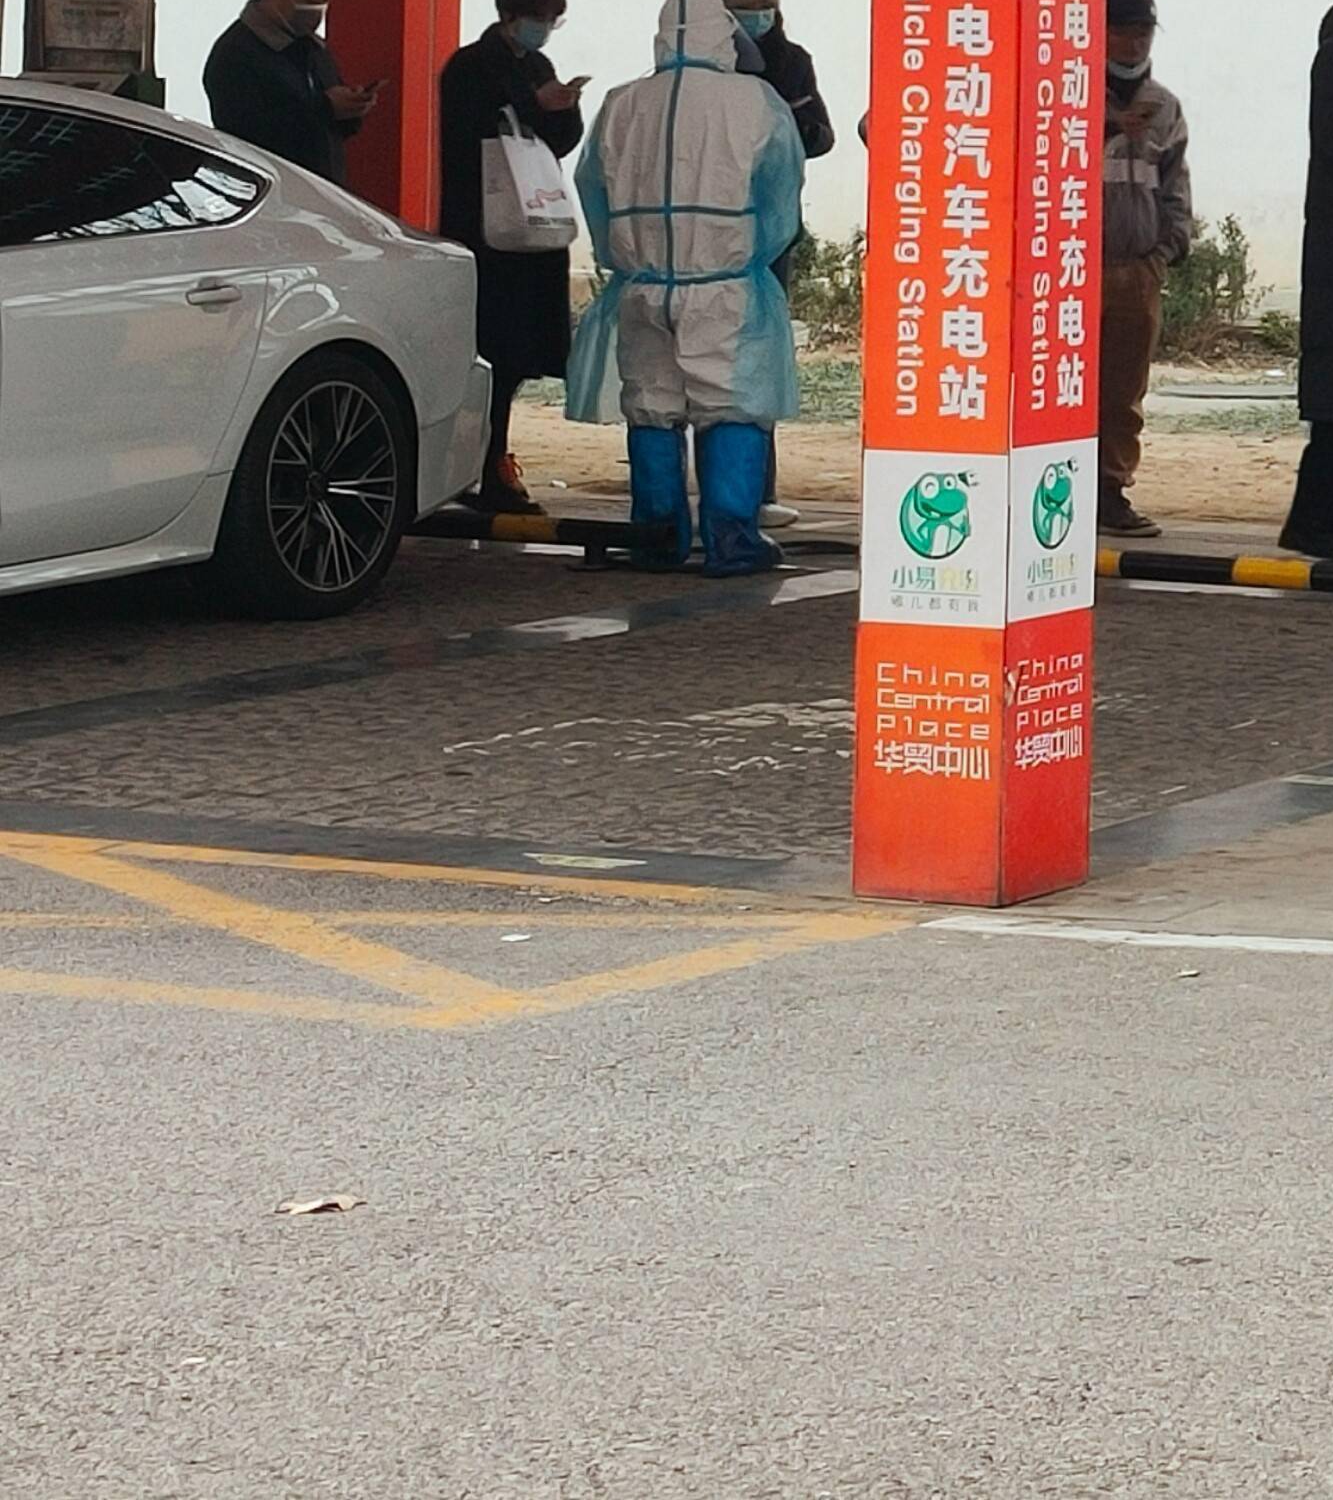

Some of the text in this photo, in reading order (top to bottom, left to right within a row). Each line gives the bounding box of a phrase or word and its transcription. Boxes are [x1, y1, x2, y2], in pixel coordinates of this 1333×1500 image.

[894, 84, 931, 263] Charging
[1031, 78, 1054, 258] Charging
[895, 277, 926, 416] Station
[1031, 272, 1051, 410] Station
[876, 662, 990, 689] China
[1017, 653, 1084, 680] China
[876, 687, 990, 714] Central
[1016, 673, 1084, 706] Central
[876, 713, 990, 741] Place
[1016, 702, 1083, 733] Place
[873, 738, 990, 781] 华贸中心
[1014, 724, 1084, 771] 华贸中心
